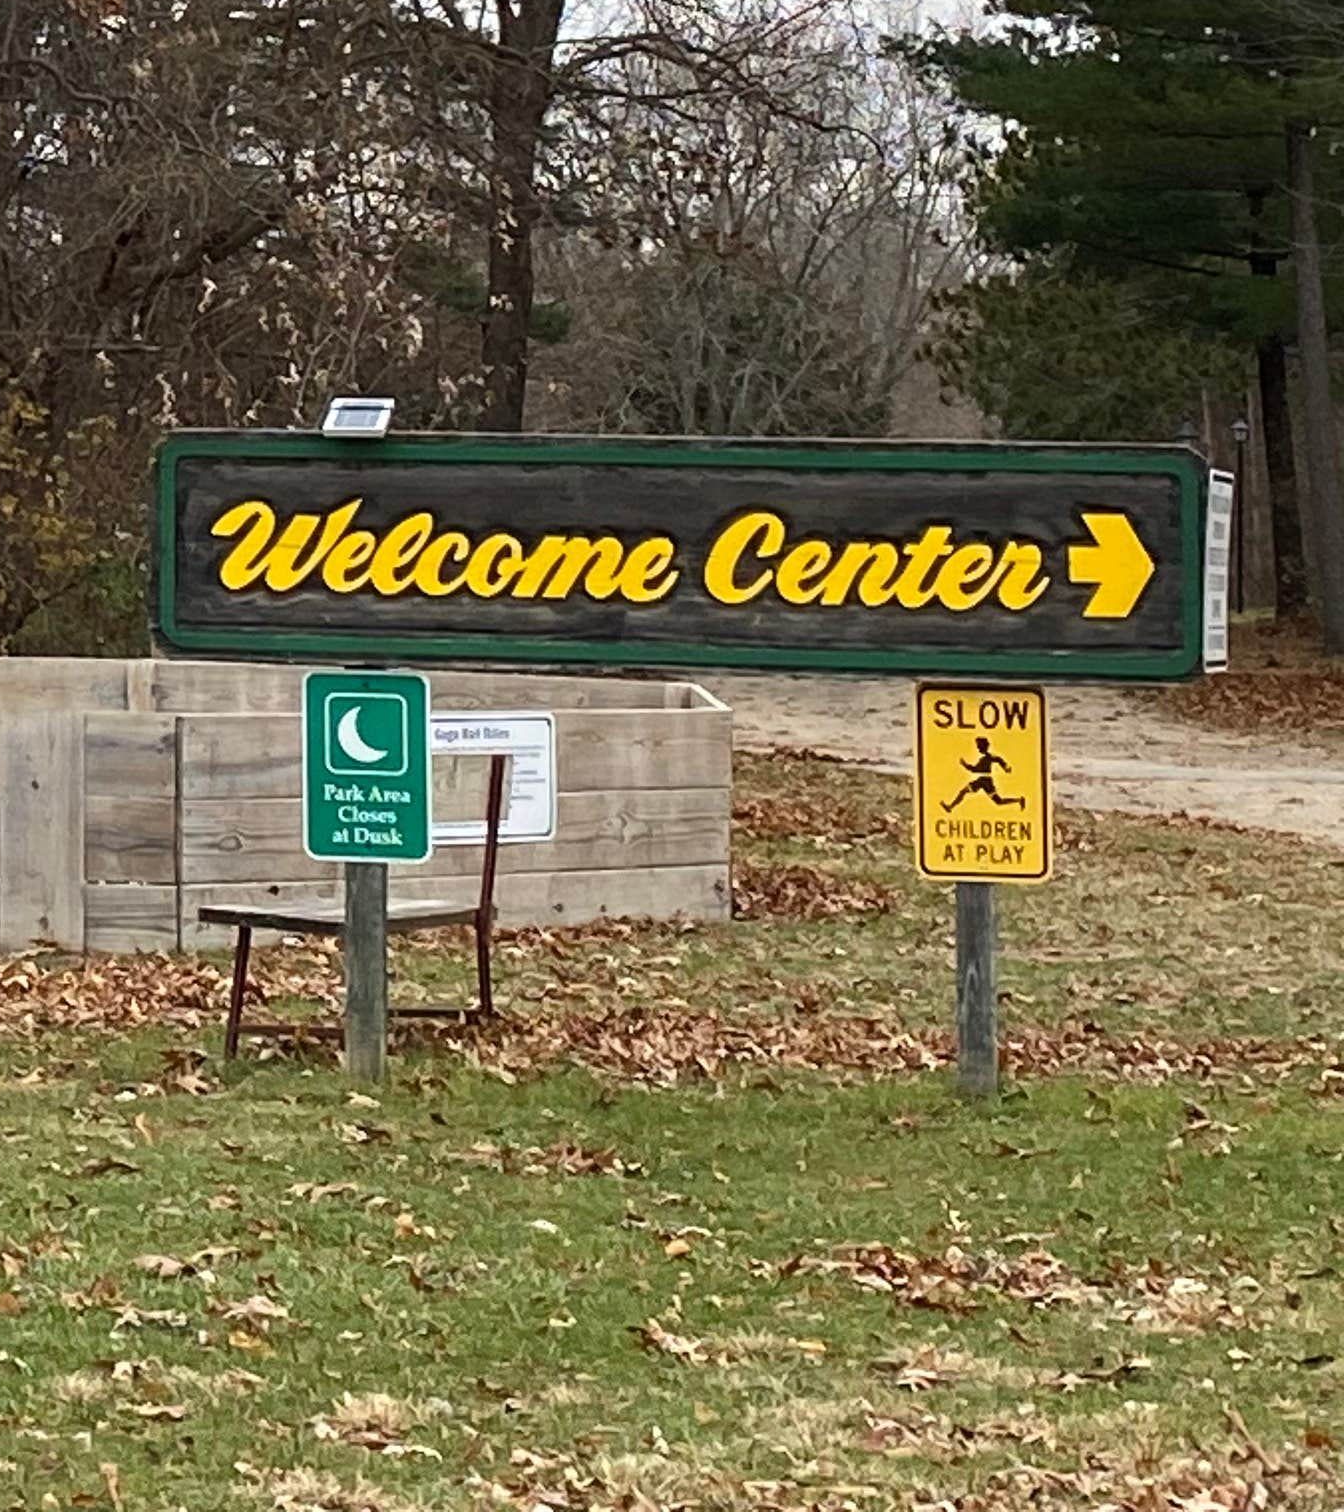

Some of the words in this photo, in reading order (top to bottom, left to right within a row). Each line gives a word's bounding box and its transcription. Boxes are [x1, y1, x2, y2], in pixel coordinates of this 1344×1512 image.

[211, 498, 679, 603] Welcome
[704, 511, 1050, 611] Center
[933, 699, 1029, 730] SLOW
[323, 783, 365, 802] Park
[368, 785, 411, 804] Area
[337, 805, 398, 824] Closes
[332, 828, 350, 844] at
[354, 827, 403, 846] Dusk
[934, 819, 1032, 841] CHILDREN
[943, 843, 965, 863] AT
[975, 844, 1025, 865] PLAY
